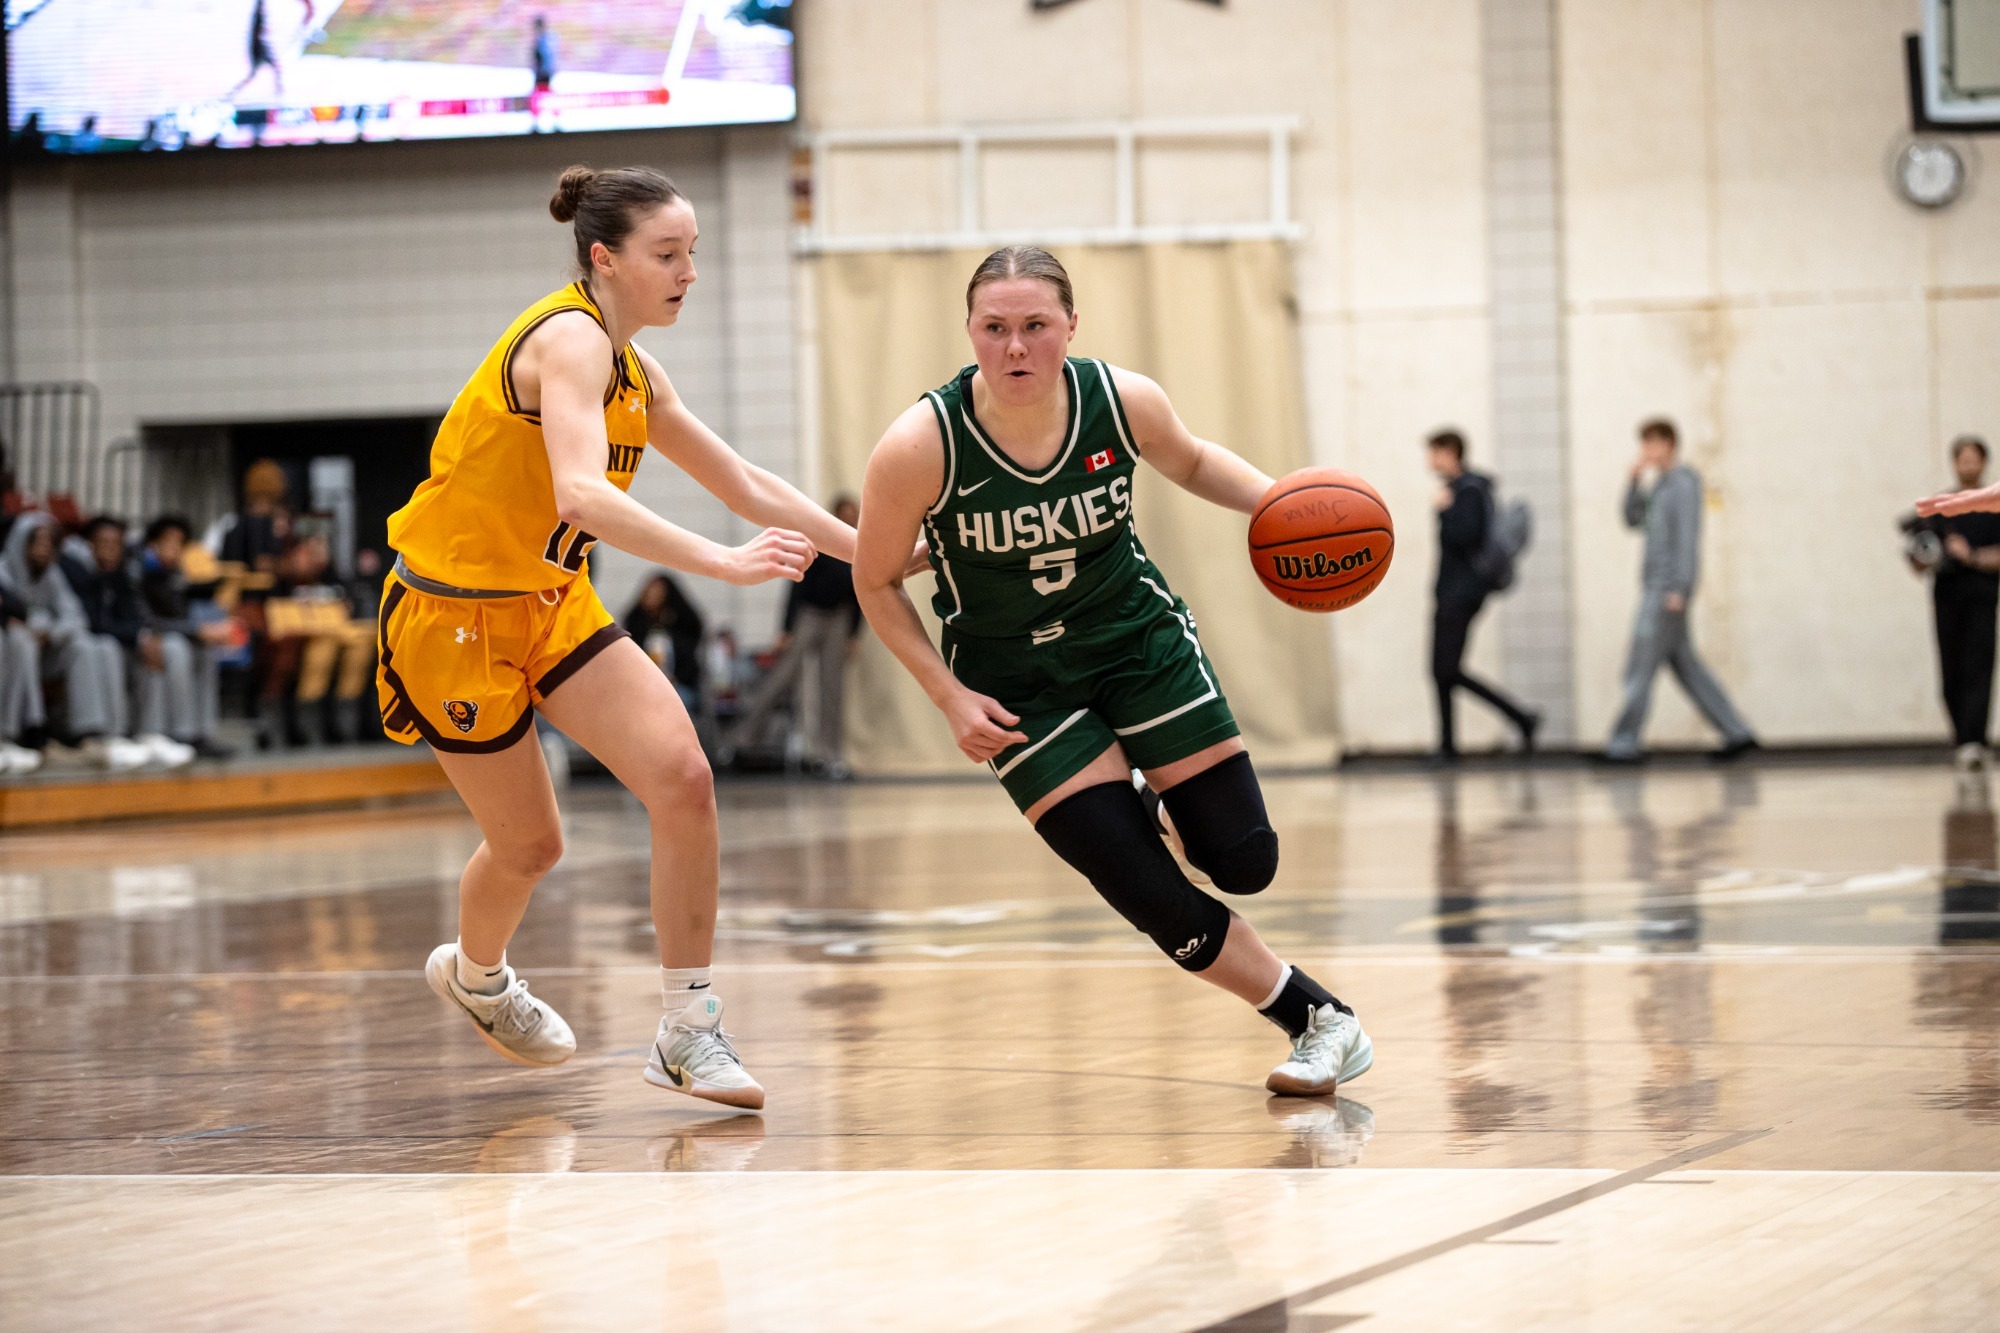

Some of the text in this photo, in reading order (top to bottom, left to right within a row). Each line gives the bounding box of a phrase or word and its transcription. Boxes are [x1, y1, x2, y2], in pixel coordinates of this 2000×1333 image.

[606, 441, 644, 473] NIT
[956, 476, 1131, 553] HUSKIES
[1029, 547, 1077, 596] 5
[1272, 546, 1374, 580] Wilson
